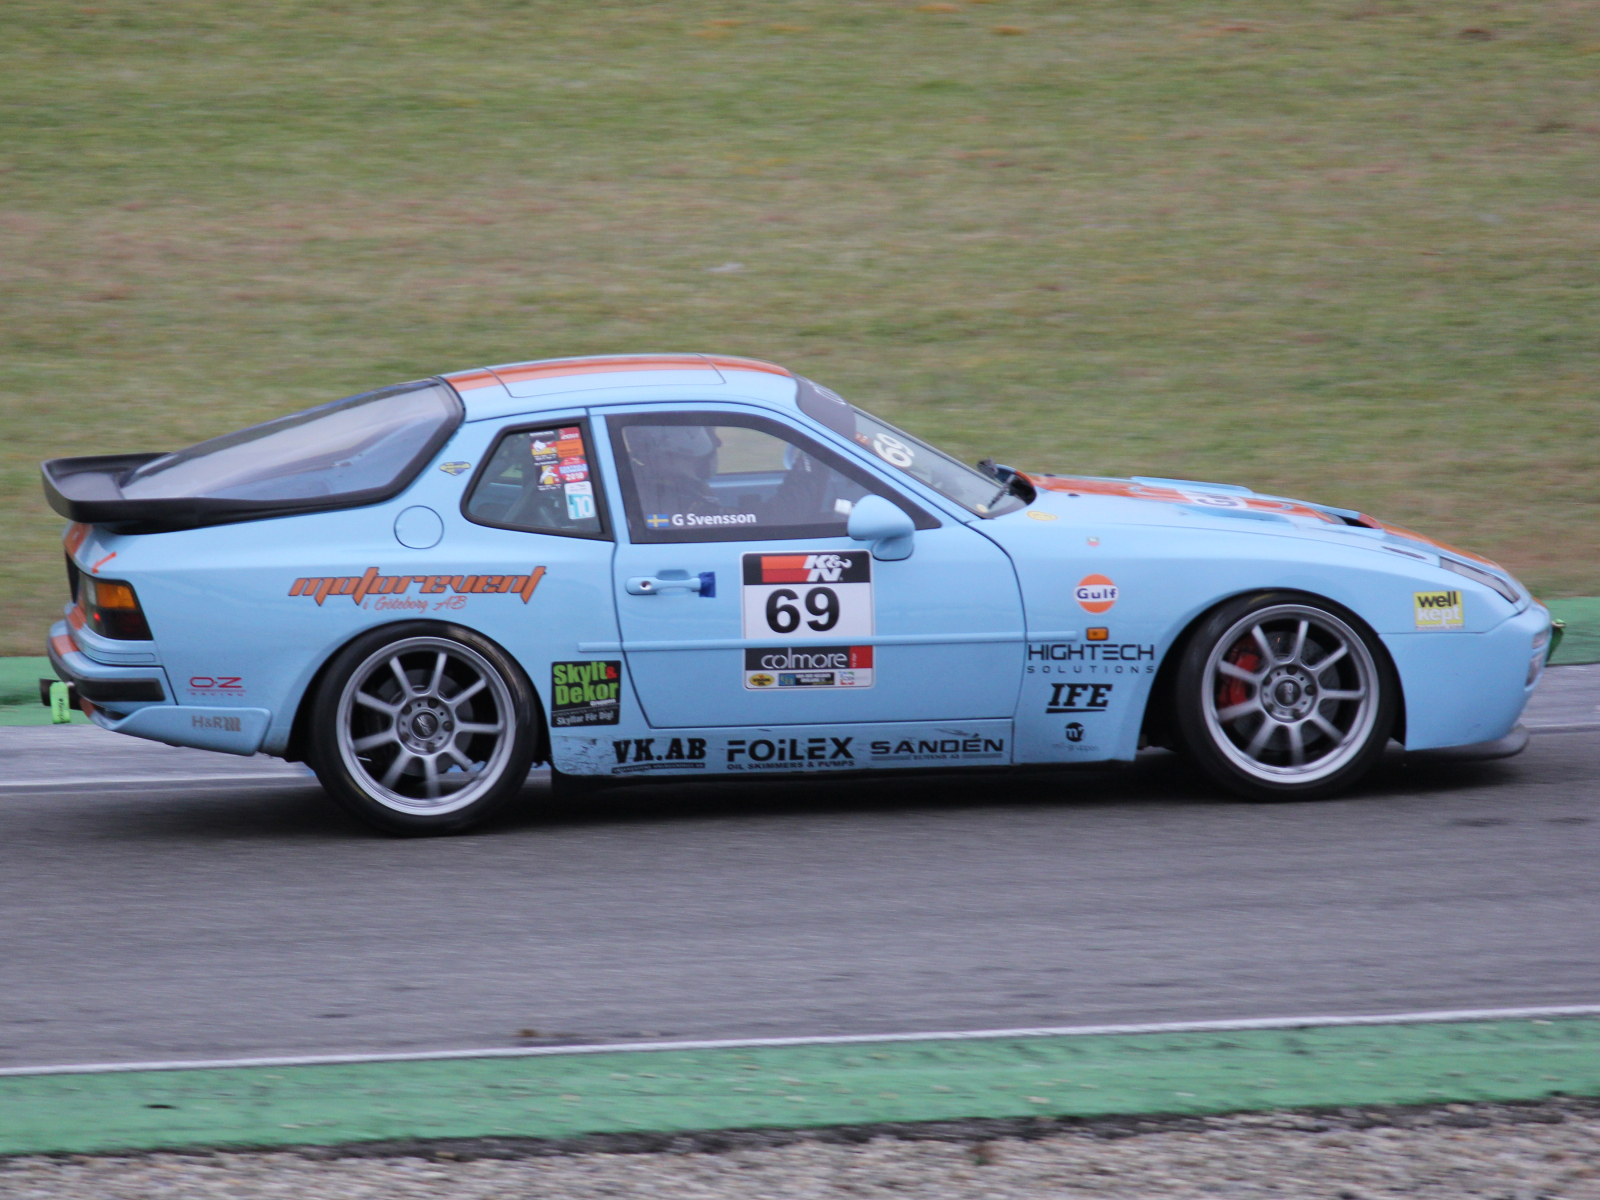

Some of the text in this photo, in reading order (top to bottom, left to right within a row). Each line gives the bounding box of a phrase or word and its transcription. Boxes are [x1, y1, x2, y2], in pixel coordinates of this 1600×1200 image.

[671, 513, 757, 526] G Svensson
[288, 566, 547, 607] motorevent
[1076, 588, 1117, 599] Gulf
[374, 596, 429, 614] Göteborg
[1417, 591, 1457, 607] well
[765, 586, 840, 634] 69
[1417, 604, 1461, 628] kept
[761, 646, 848, 669] colmore
[1028, 644, 1155, 660] HIGHTECH
[1027, 665, 1155, 674] SOLUTIONS
[555, 681, 619, 706] Dekor
[1048, 683, 1113, 708] IFE
[612, 737, 707, 763] VK.AB
[870, 733, 1004, 754] SANDÉN
[747, 762, 804, 770] SKIMMERS
[818, 760, 855, 768] PUMPS
